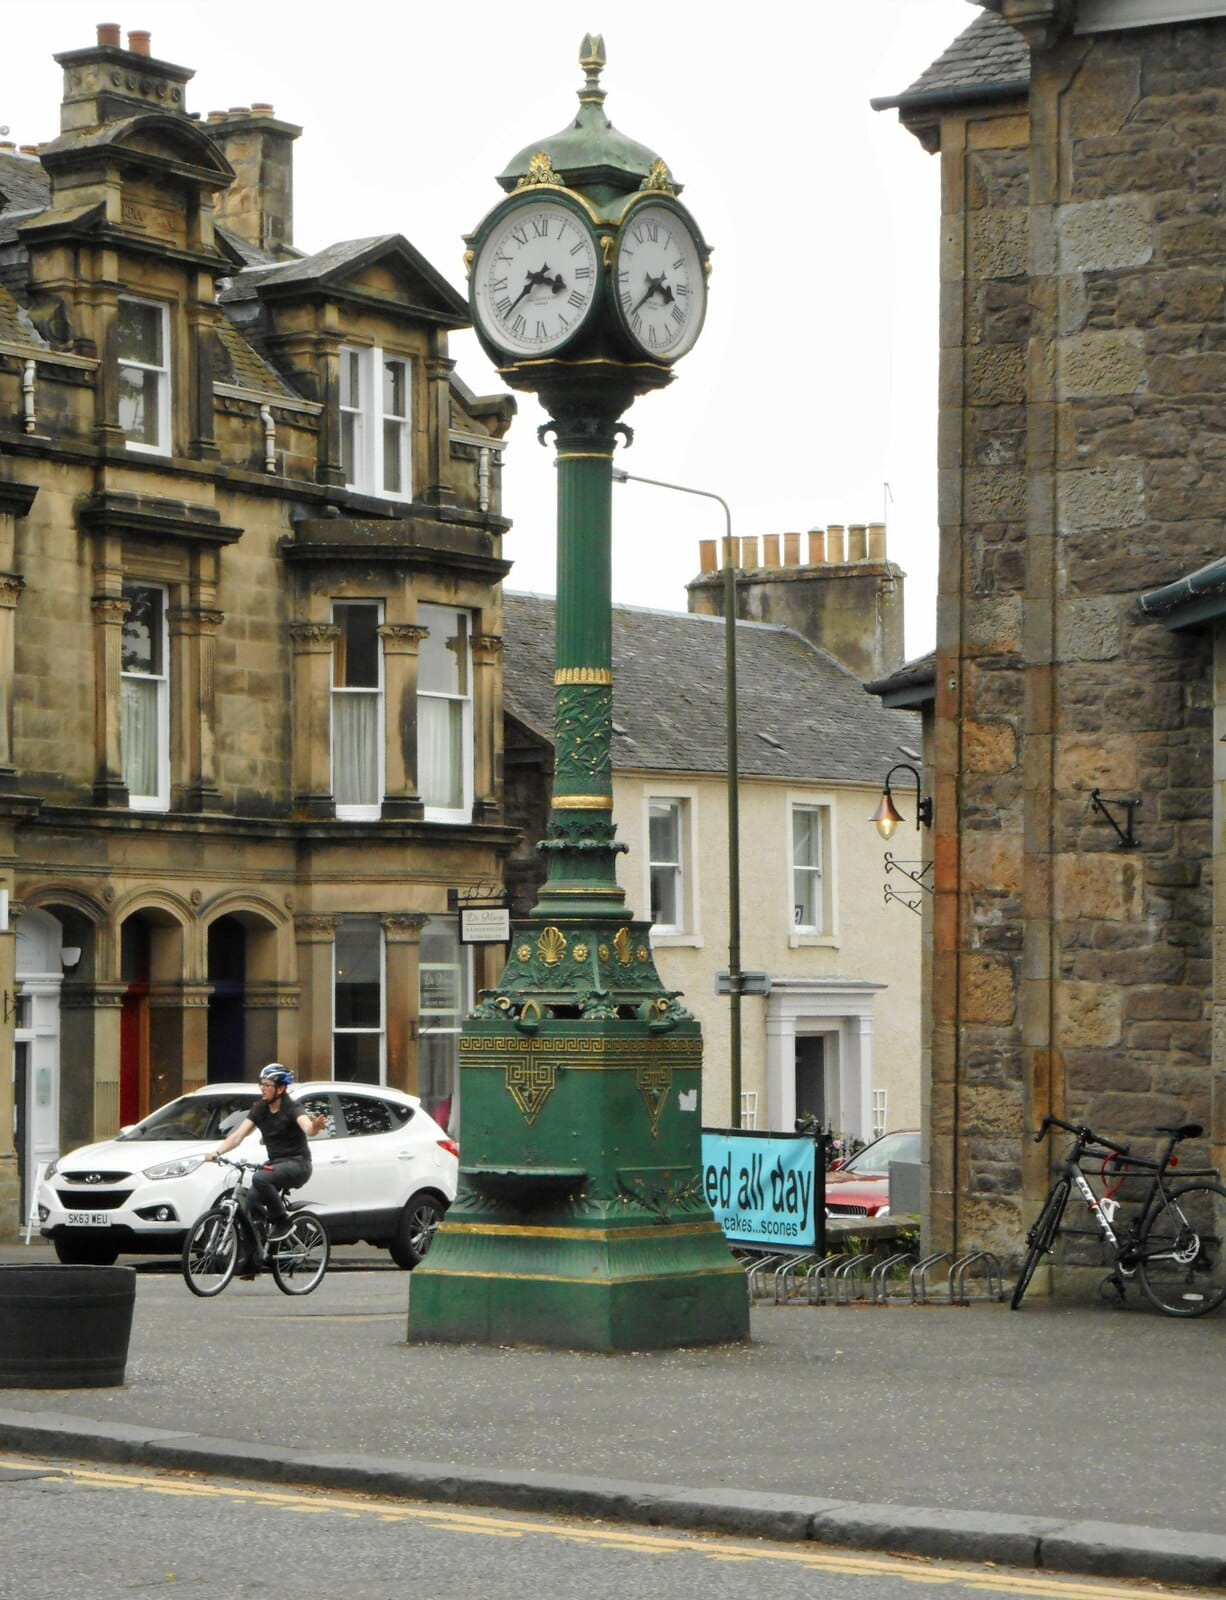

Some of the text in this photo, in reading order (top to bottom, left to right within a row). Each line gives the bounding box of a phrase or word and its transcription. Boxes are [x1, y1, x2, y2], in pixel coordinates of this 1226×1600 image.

[575, 267, 590, 279] III
[702, 1151, 811, 1231] ed all day
[68, 1213, 108, 1224] SK63 WEU
